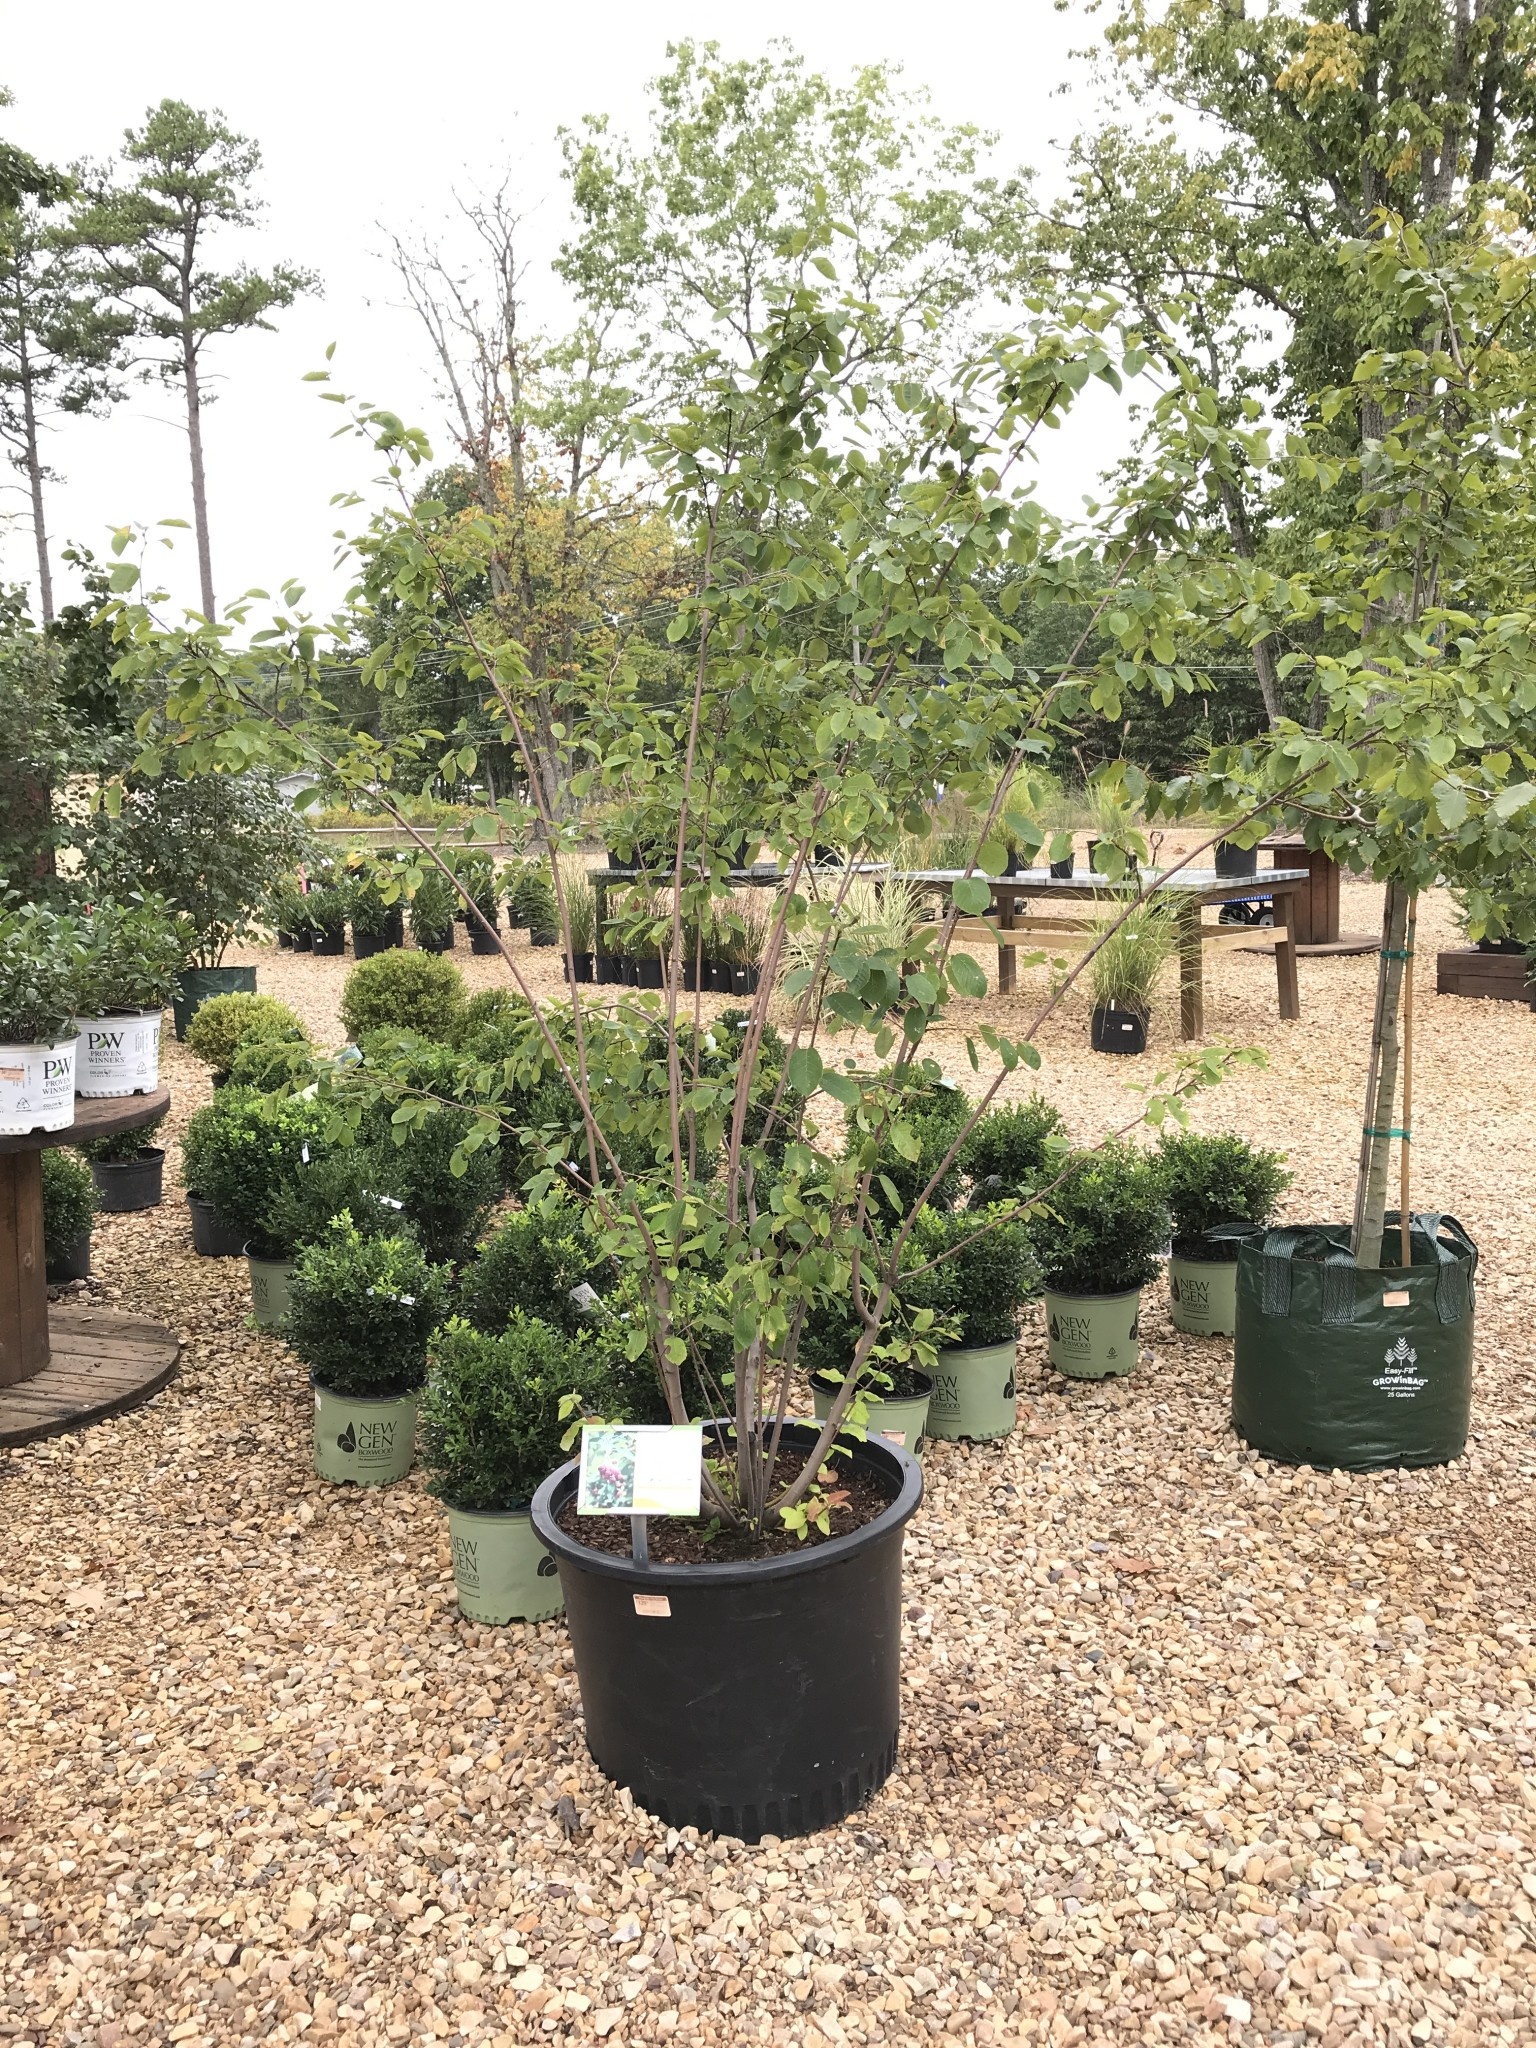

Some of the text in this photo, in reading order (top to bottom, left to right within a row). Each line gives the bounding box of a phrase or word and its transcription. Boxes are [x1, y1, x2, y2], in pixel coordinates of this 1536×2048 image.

[87, 1032, 125, 1050] PW
[42, 1056, 72, 1080] PW
[42, 1084, 72, 1095] WINNERS
[45, 1077, 71, 1088] PROVEN
[252, 1275, 268, 1288] EW
[1180, 1278, 1210, 1292] NEW
[254, 1285, 268, 1298] EN
[1180, 1289, 1208, 1303] GEN
[1181, 1300, 1210, 1309] BOXWOOD
[1059, 1315, 1091, 1330] NEW
[1060, 1327, 1091, 1342] GEN
[1062, 1339, 1091, 1348] BOXWOOD
[359, 1420, 398, 1436] NEW
[358, 1434, 394, 1449] GEN
[358, 1447, 394, 1456] BOXWOOD
